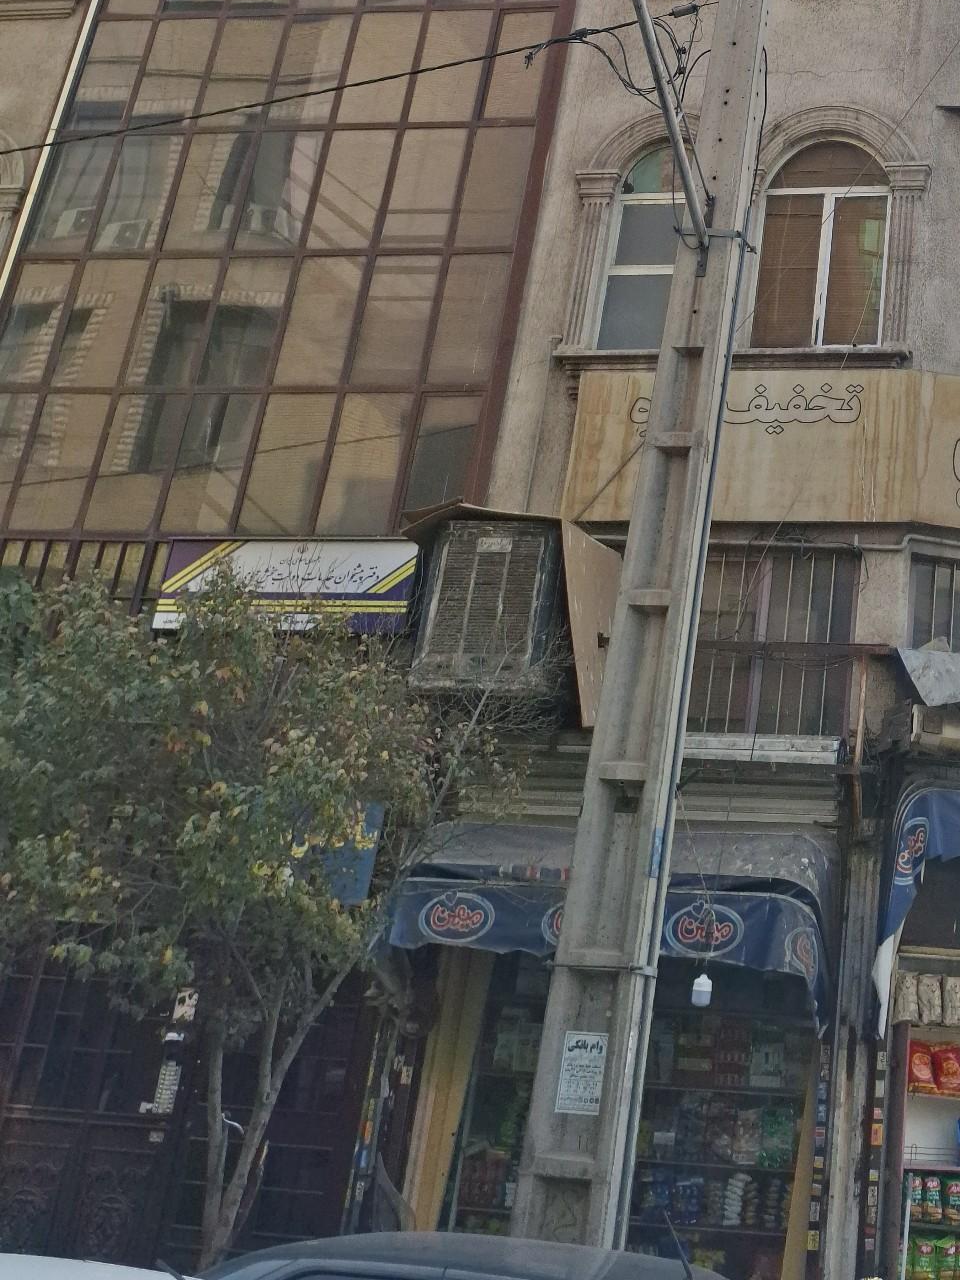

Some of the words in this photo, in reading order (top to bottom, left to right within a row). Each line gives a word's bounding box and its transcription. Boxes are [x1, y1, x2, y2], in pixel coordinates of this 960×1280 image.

[430, 905, 485, 932] میهن
[567, 1039, 589, 1054] بانکی
[589, 1040, 603, 1055] وام
